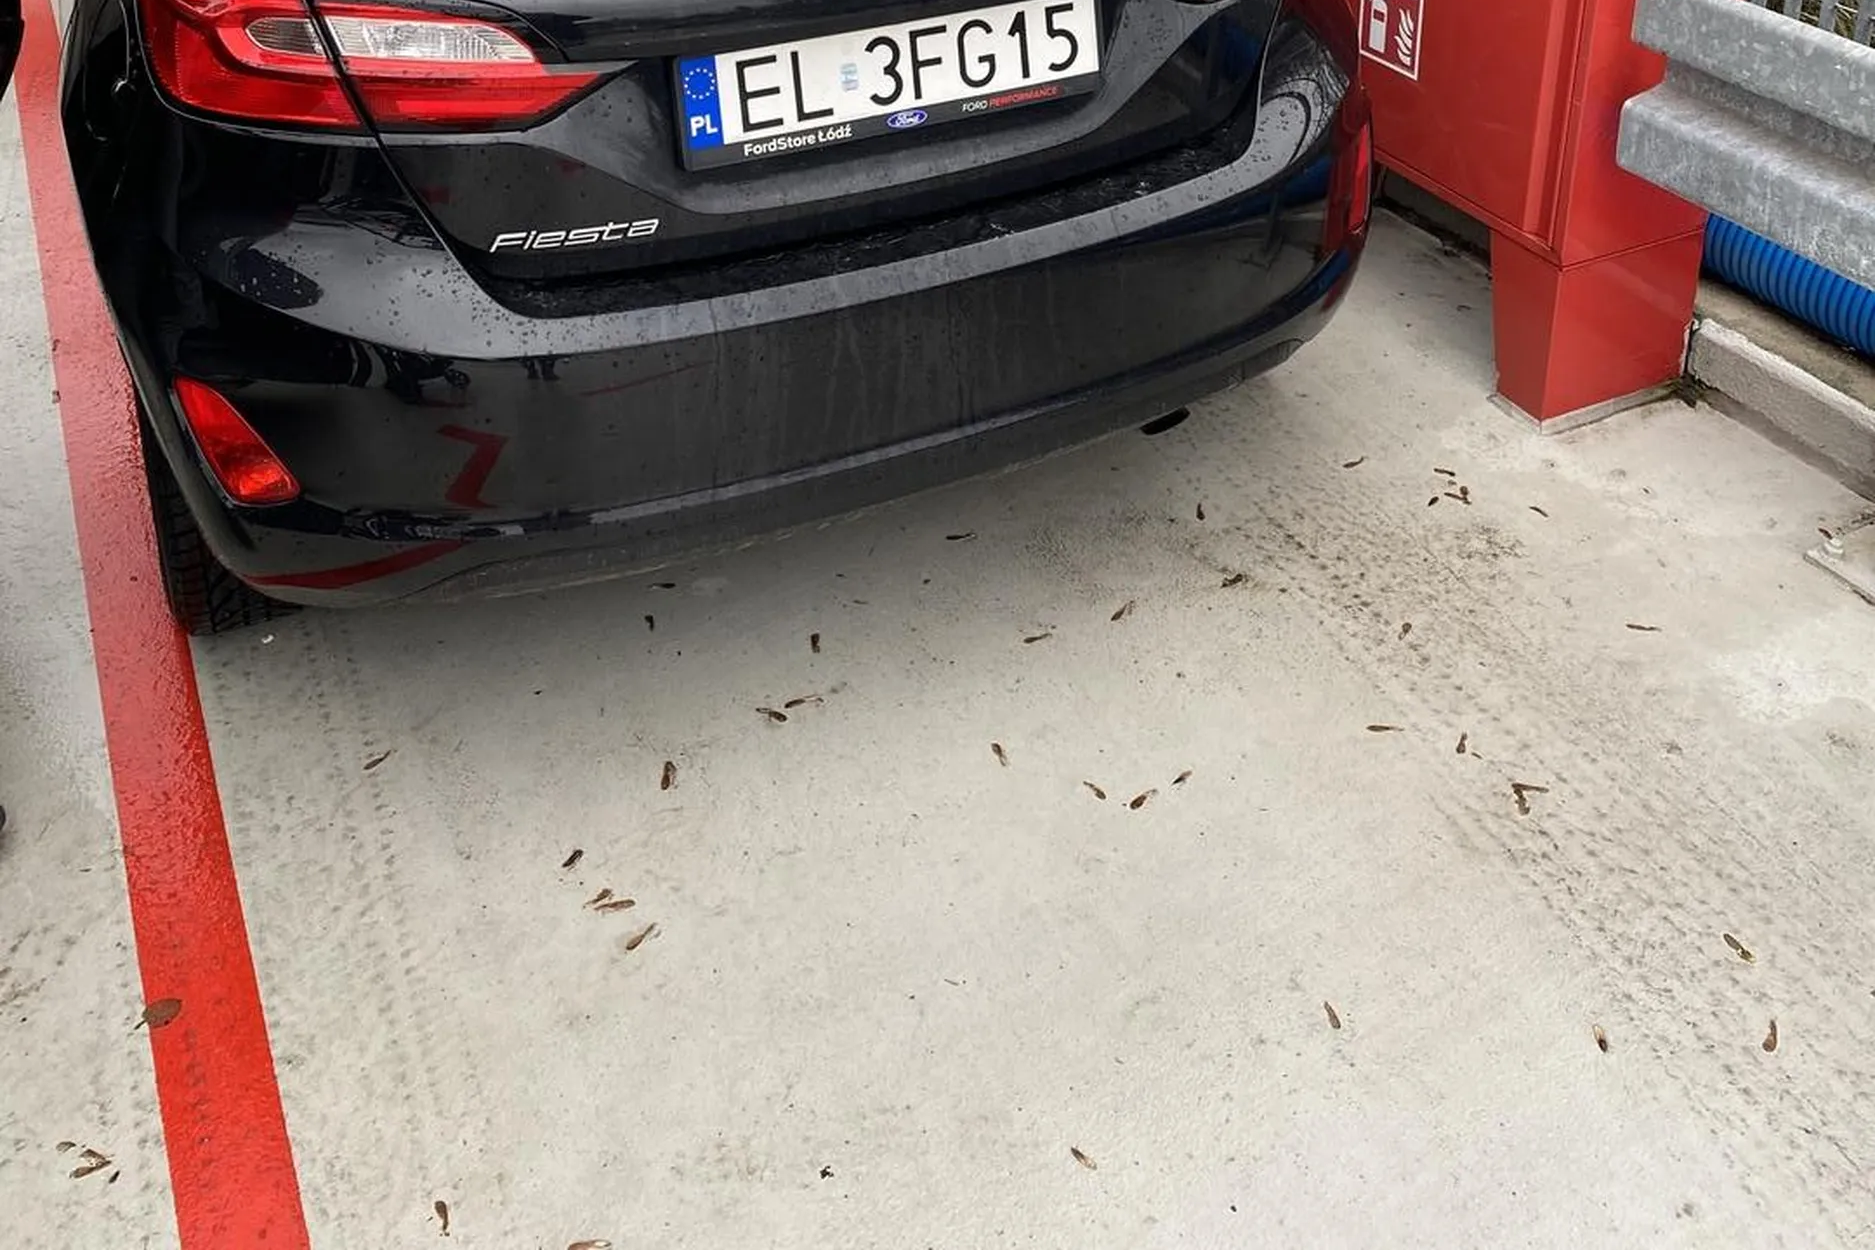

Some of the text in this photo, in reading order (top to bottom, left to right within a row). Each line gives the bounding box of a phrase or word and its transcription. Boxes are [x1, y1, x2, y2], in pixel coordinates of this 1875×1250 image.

[735, 2, 1080, 133] EL 3FG15
[961, 86, 1059, 112] FORD PERFORMANCE
[690, 114, 719, 138] PL
[743, 123, 853, 157] FordStore Łódź
[489, 217, 660, 253] Fiesta
